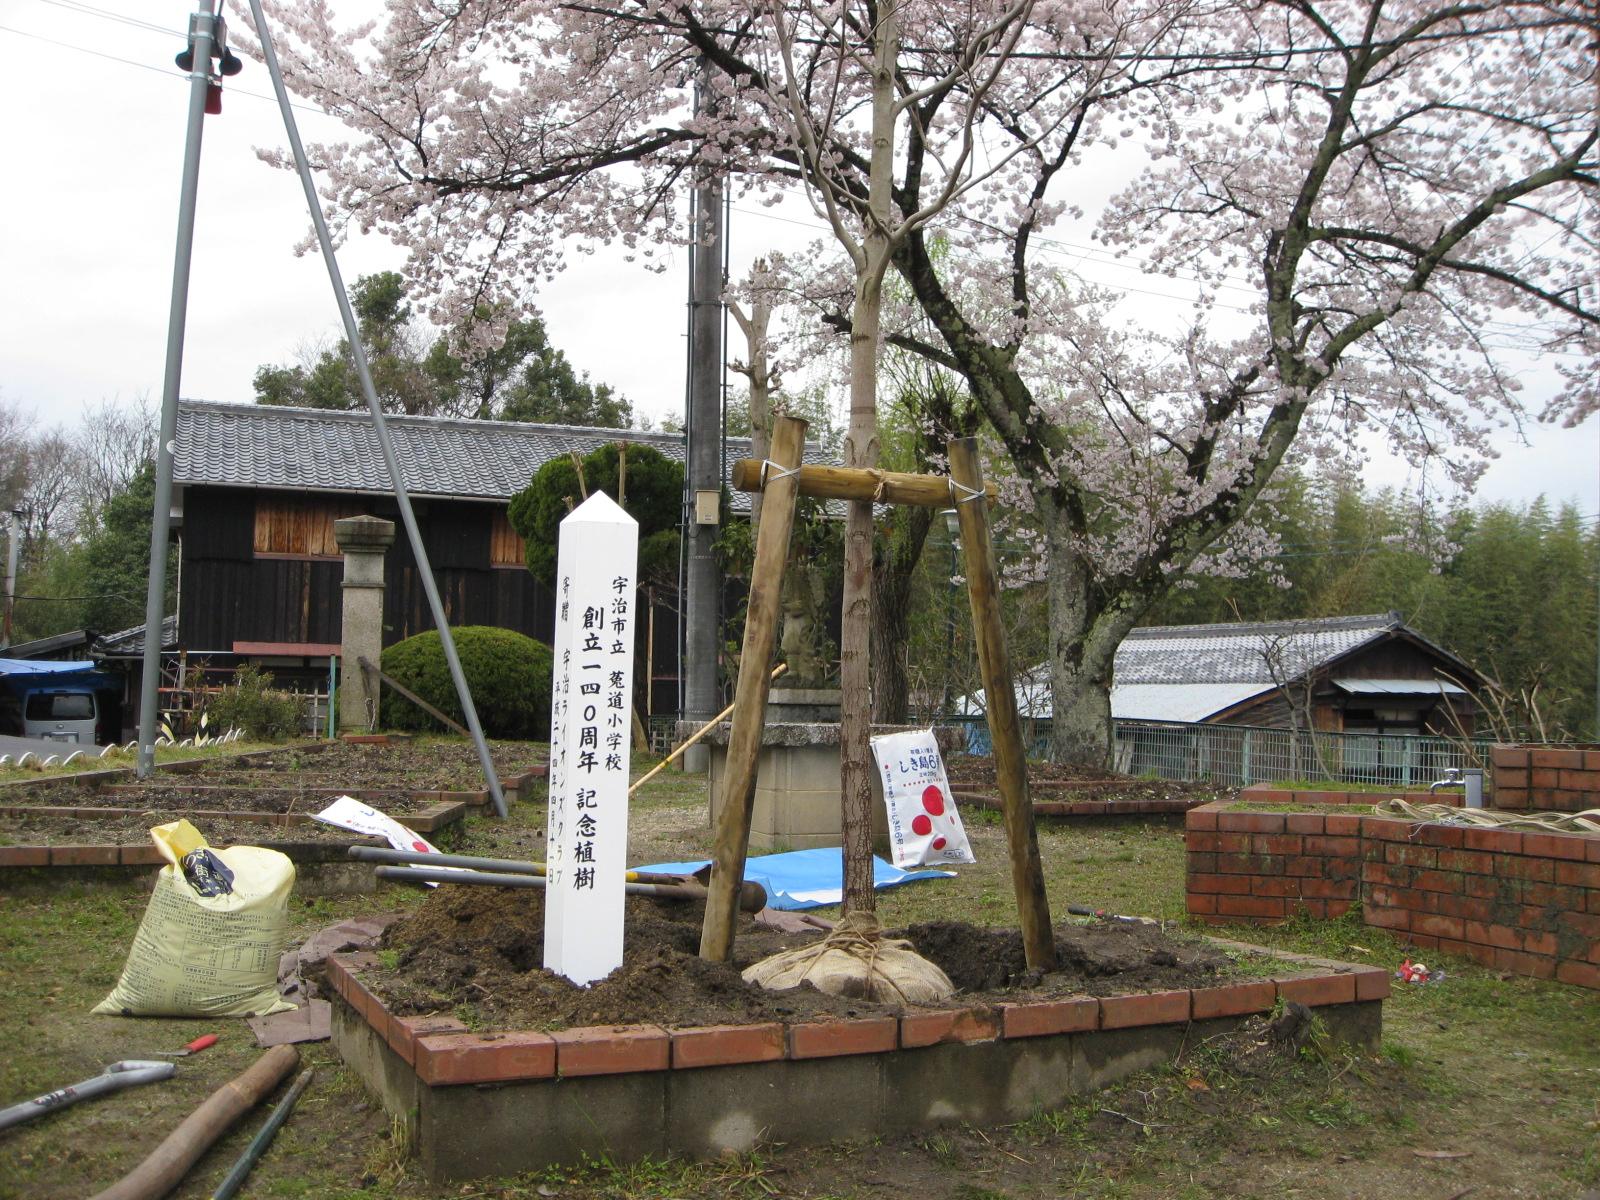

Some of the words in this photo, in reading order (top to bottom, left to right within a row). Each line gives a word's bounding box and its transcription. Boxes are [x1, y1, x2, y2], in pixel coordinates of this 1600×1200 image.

[609, 576, 629, 655] 宇治市立
[604, 670, 626, 772] 菟道小学校
[572, 788, 599, 891] 記念植樹
